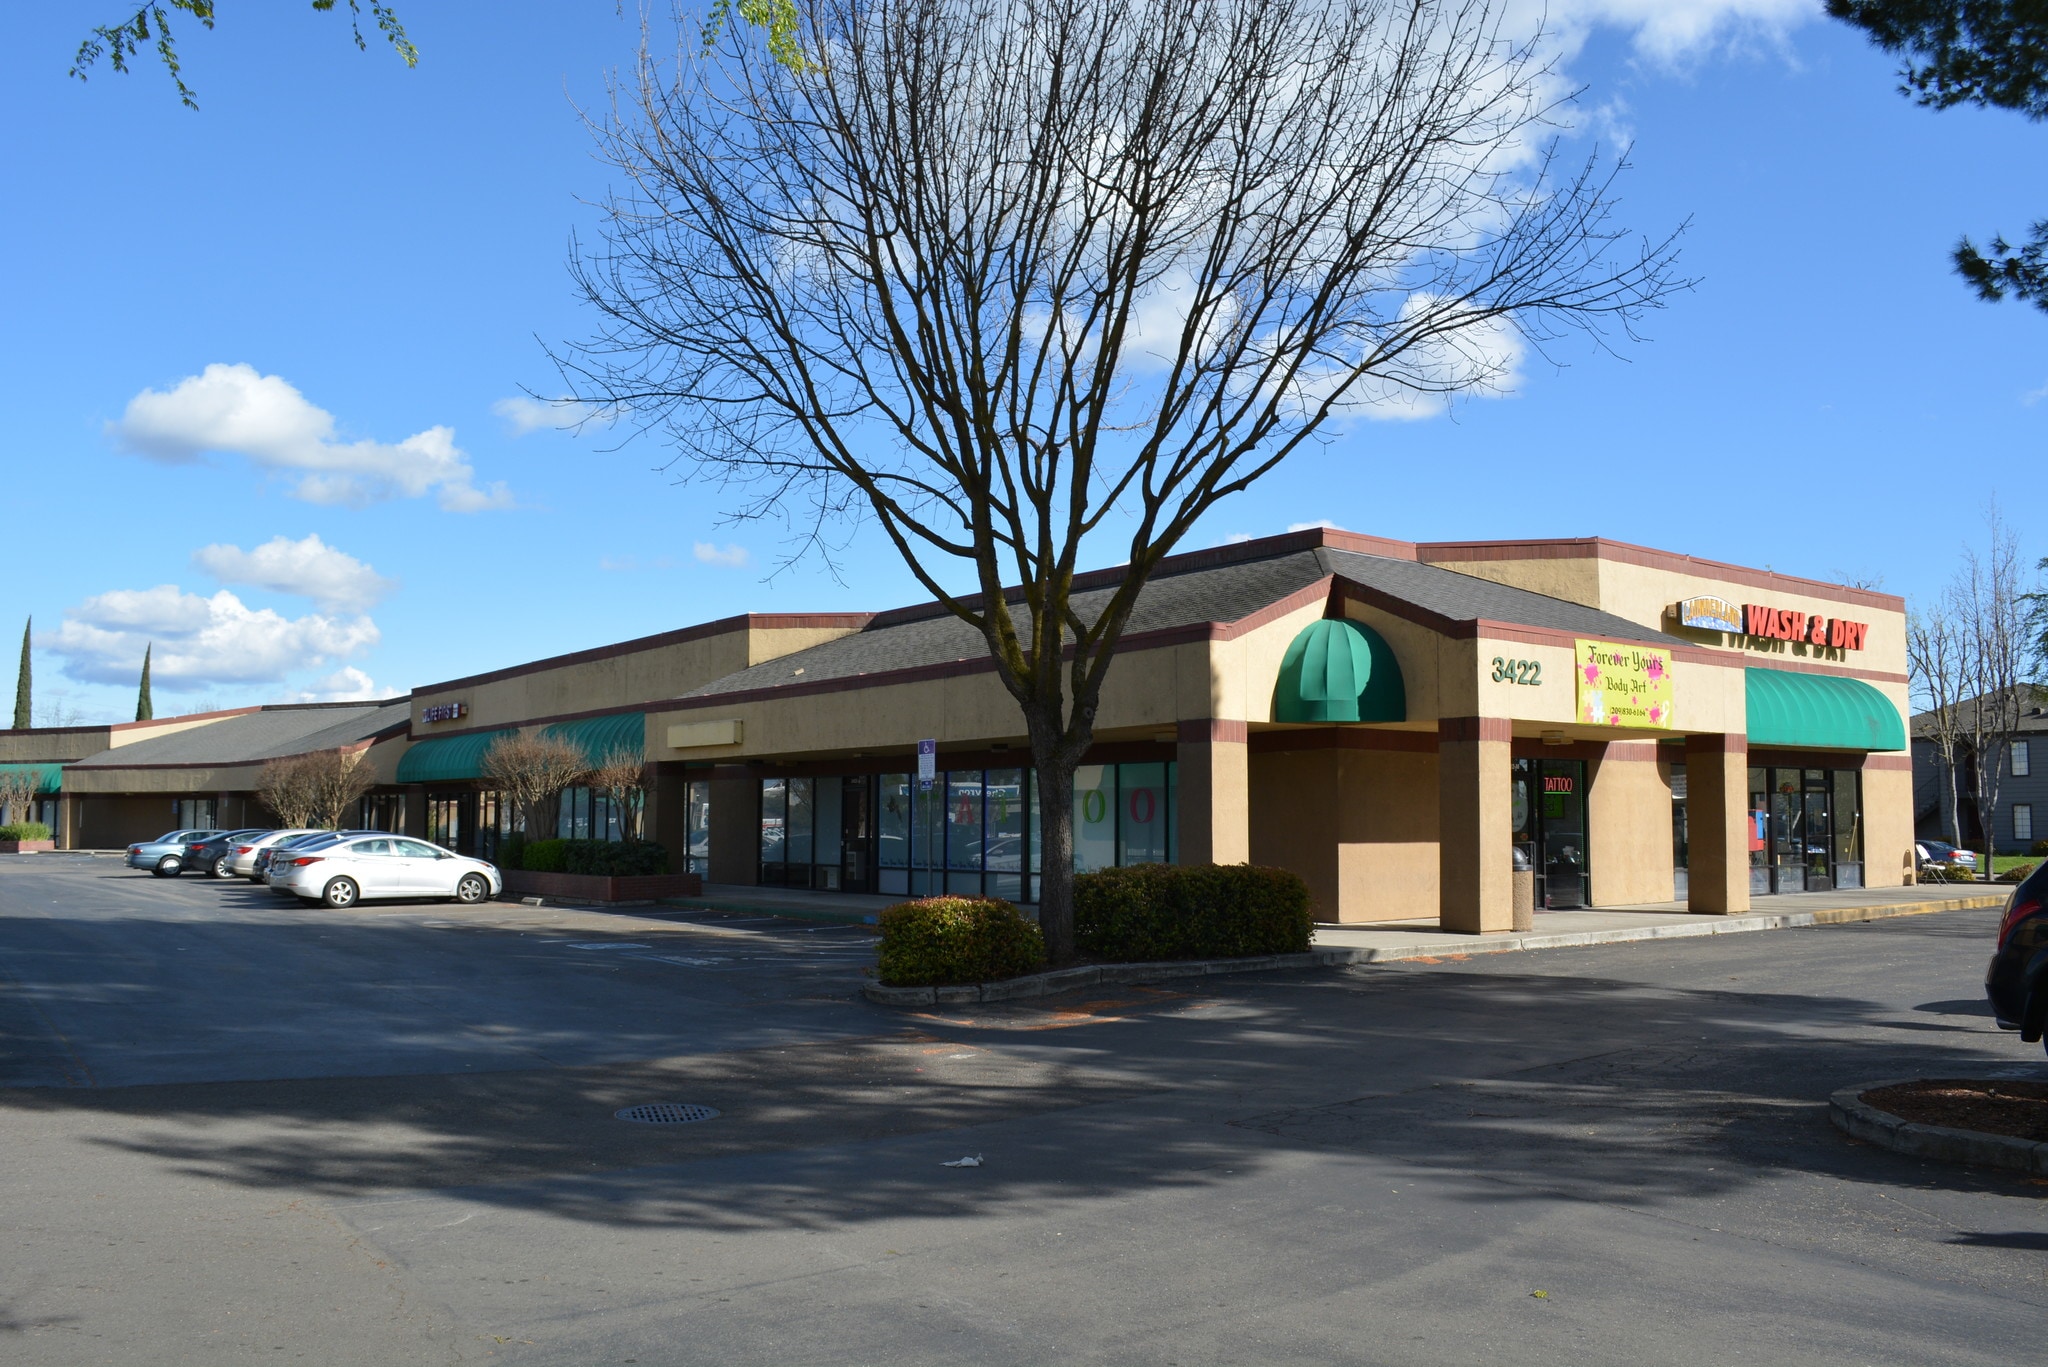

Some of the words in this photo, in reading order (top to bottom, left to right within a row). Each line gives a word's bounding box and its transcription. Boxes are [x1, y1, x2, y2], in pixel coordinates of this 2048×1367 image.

[1746, 603, 1806, 642] WASH
[1811, 614, 1827, 646] &
[1831, 618, 1869, 651] DRY
[1491, 656, 1542, 686] 3422
[1588, 645, 1630, 668] Forever
[1632, 651, 1663, 672] Yours
[1605, 676, 1629, 696] Body
[1630, 679, 1647, 694] Art
[1544, 777, 1573, 792] TATTOO
